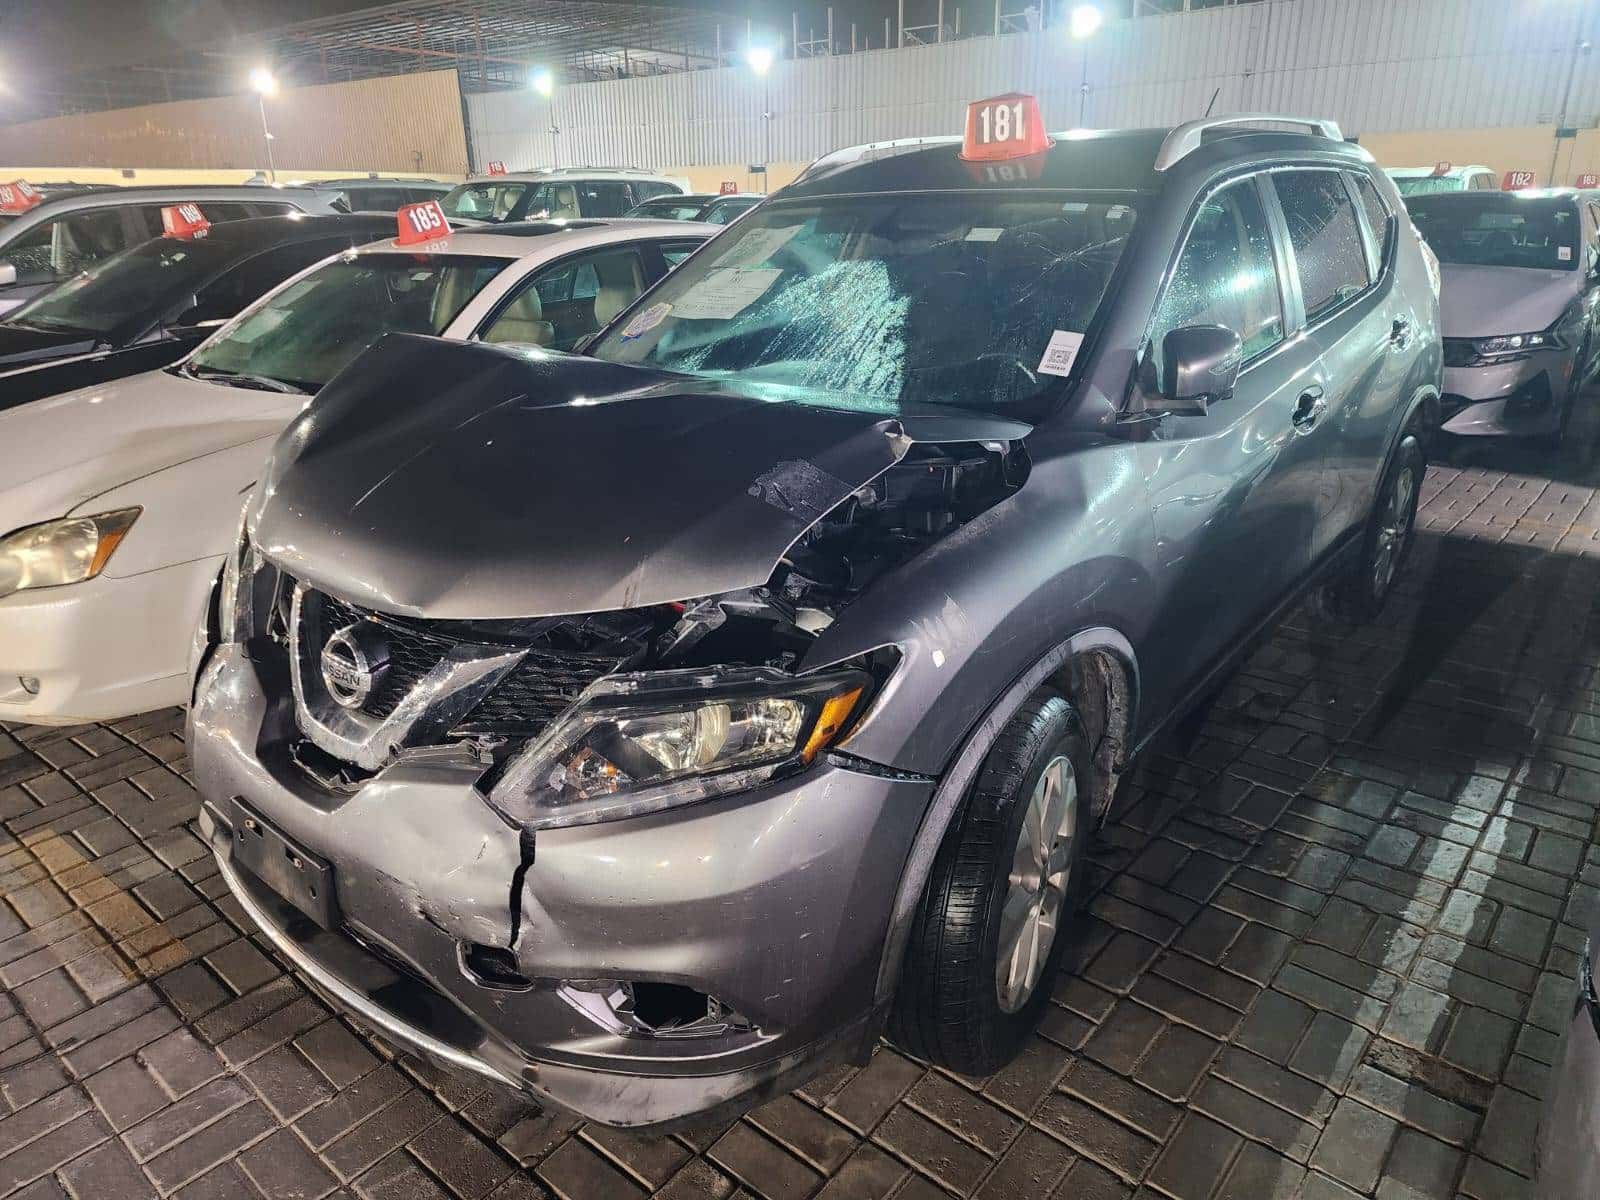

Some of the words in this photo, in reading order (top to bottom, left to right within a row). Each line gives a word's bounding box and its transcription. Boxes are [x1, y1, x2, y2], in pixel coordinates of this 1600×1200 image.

[981, 102, 1024, 144] 181
[1511, 172, 1531, 186] 182
[409, 204, 441, 233] 185
